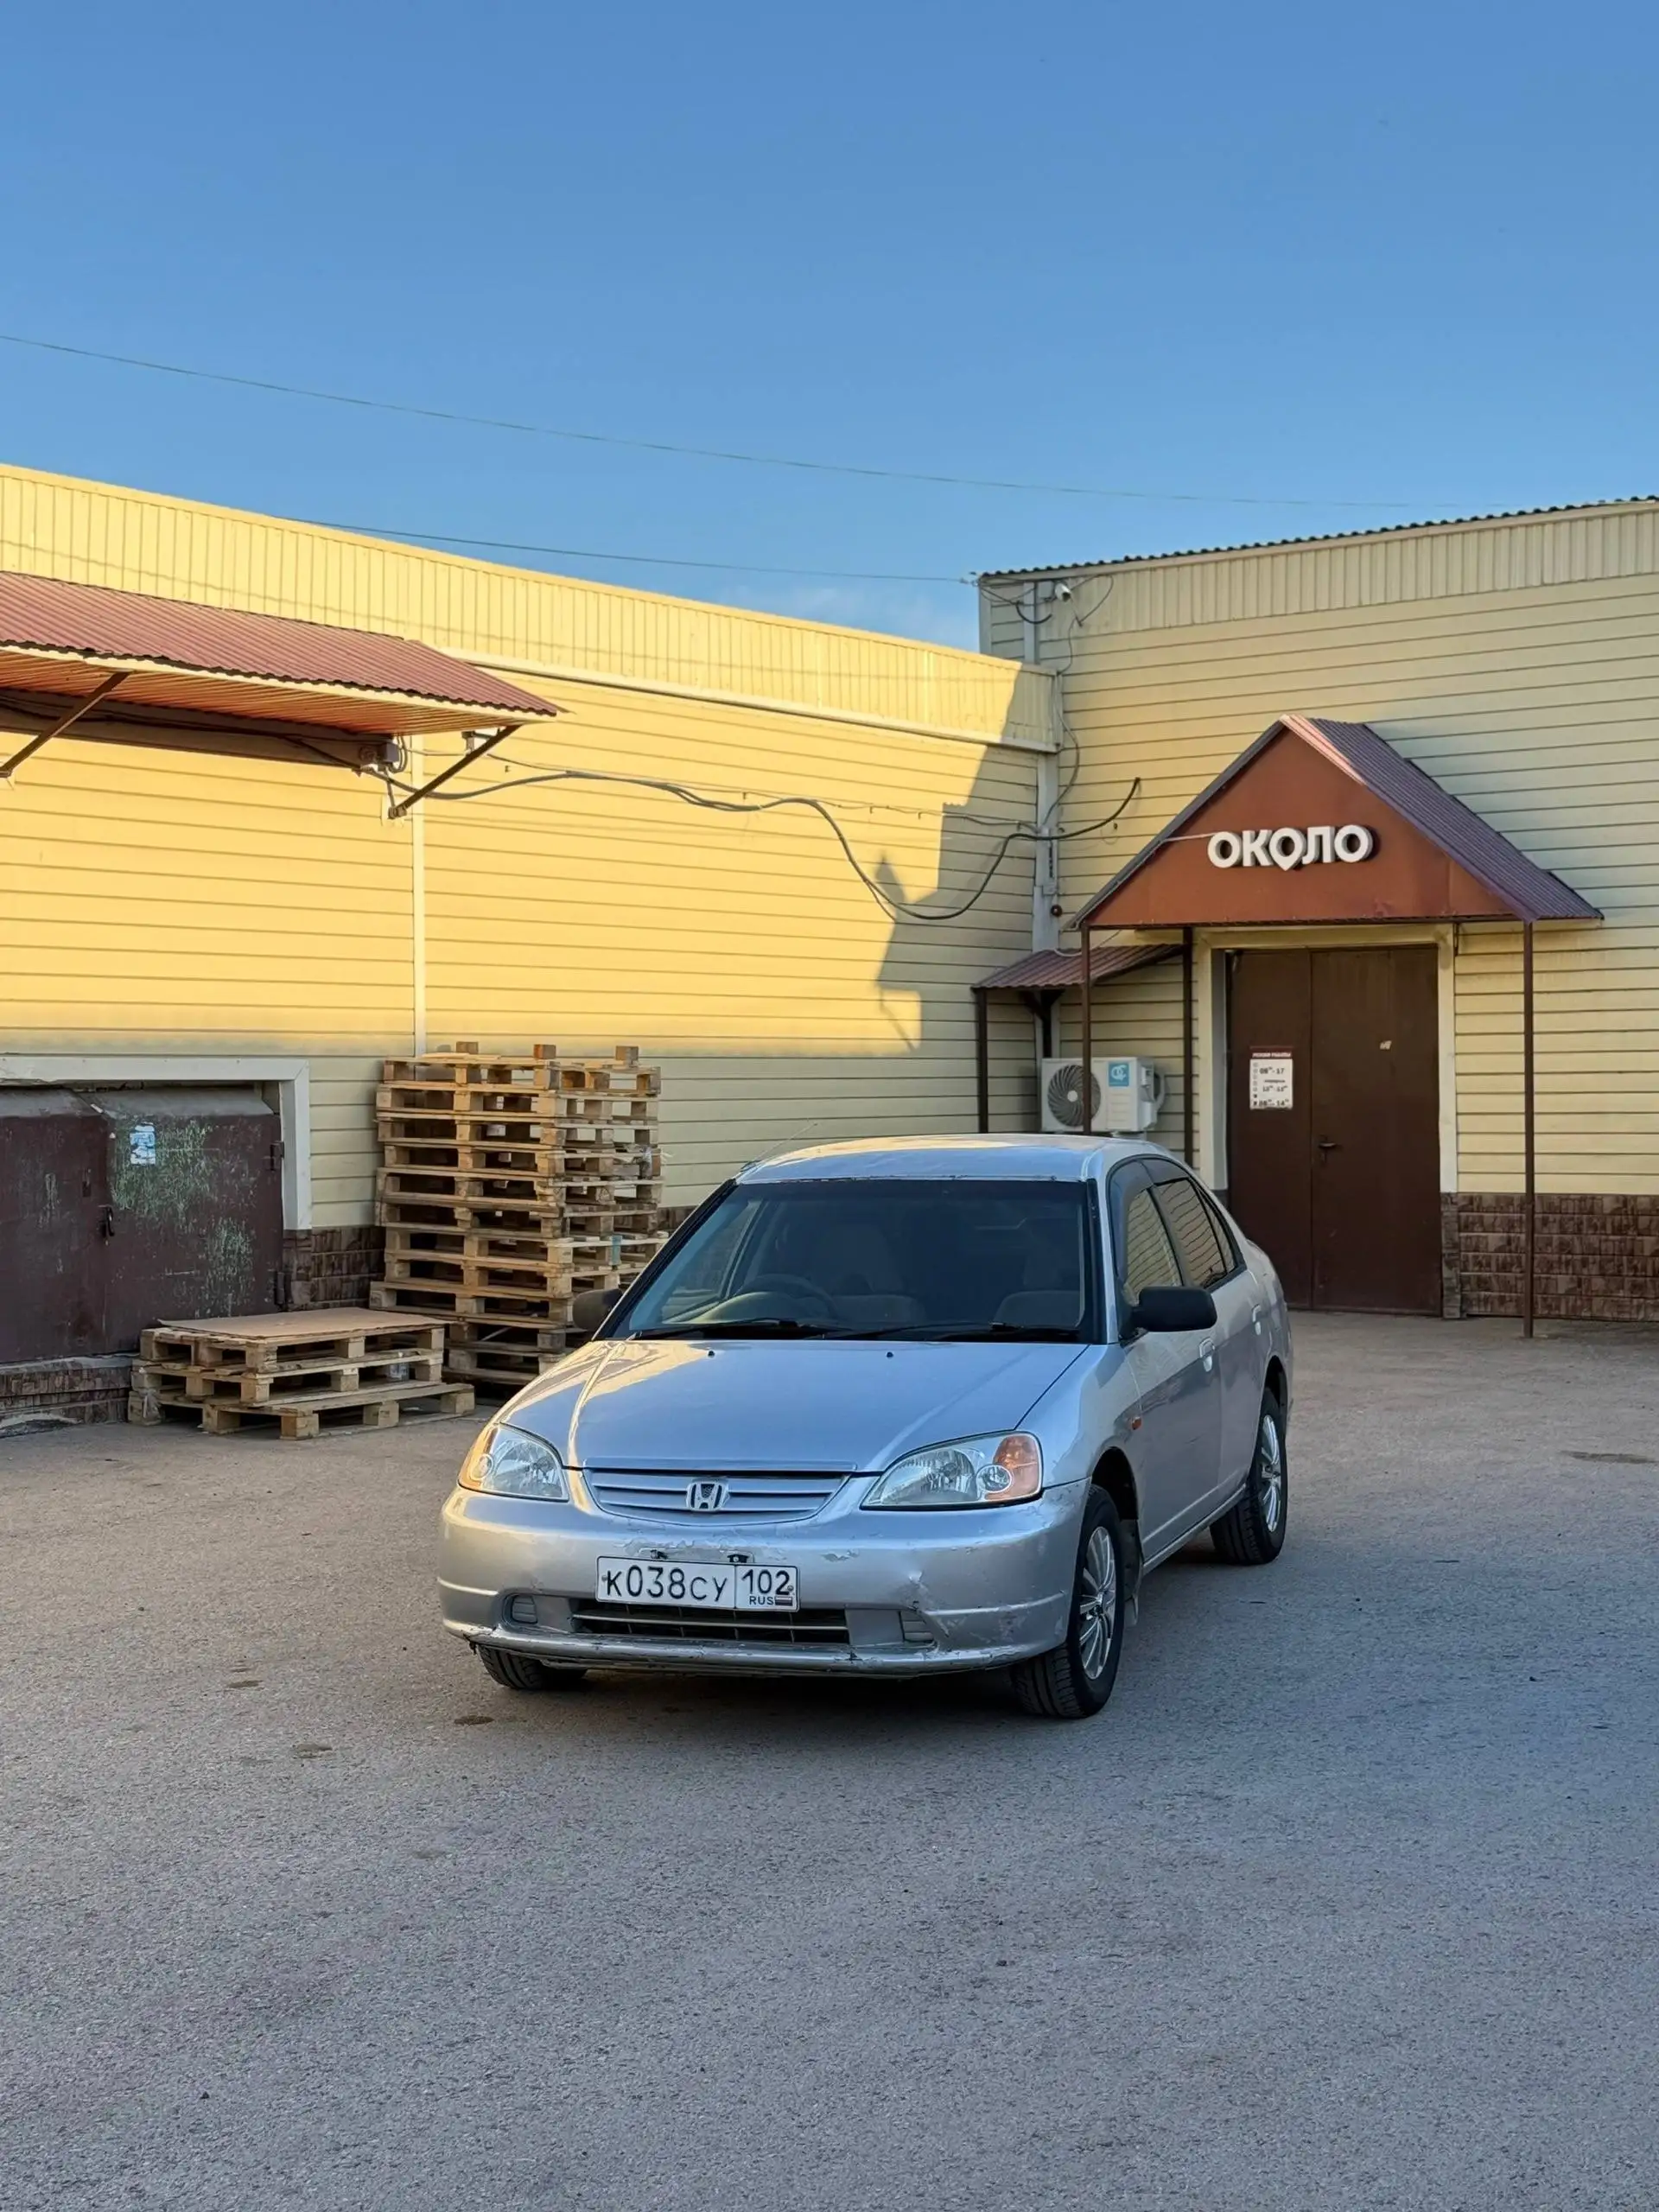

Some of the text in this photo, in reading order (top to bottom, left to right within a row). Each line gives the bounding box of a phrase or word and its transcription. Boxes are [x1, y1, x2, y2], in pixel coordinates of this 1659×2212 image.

[1207, 824, 1373, 871] ОКОЛО
[741, 1569, 791, 1595] 102
[749, 1596, 774, 1605] RUS
